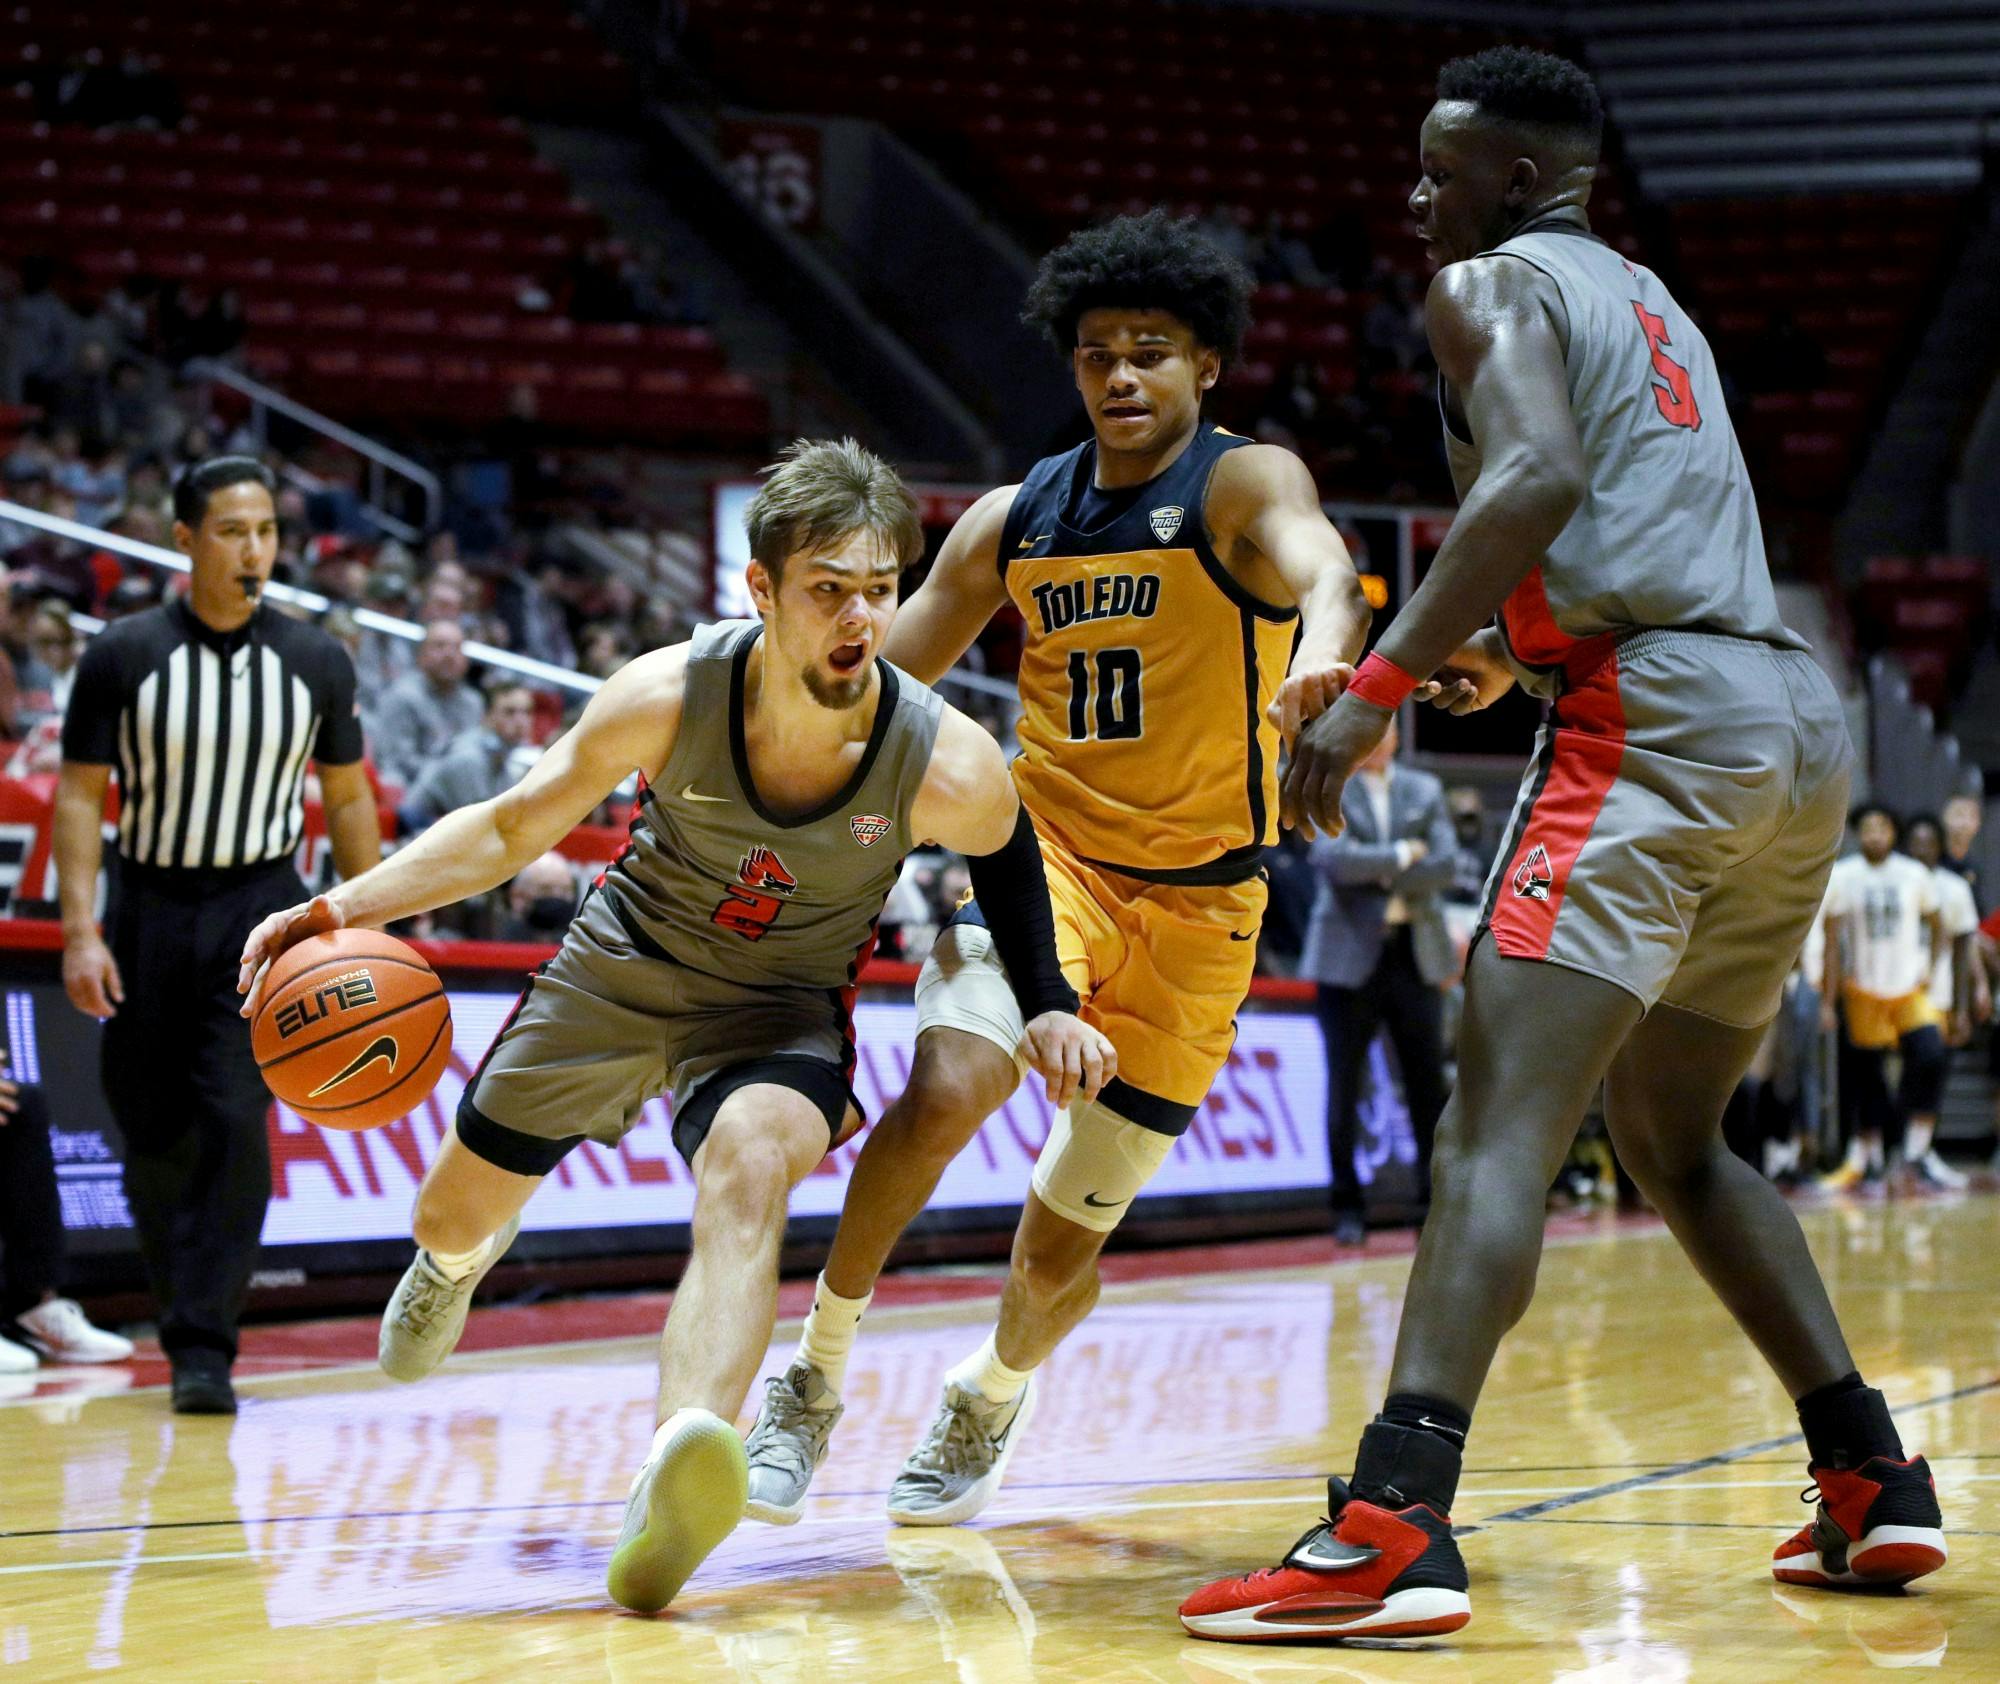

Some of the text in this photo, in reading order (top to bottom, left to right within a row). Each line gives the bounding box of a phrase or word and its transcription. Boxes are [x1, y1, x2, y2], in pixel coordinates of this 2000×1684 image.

[1629, 299, 1703, 433] 5
[1152, 516, 1181, 528] MAC
[1031, 573, 1162, 635] TOLEDO
[1066, 647, 1144, 742] 10
[853, 823, 888, 834] MAC
[710, 883, 784, 942] 2
[275, 975, 378, 1039] ELITE
